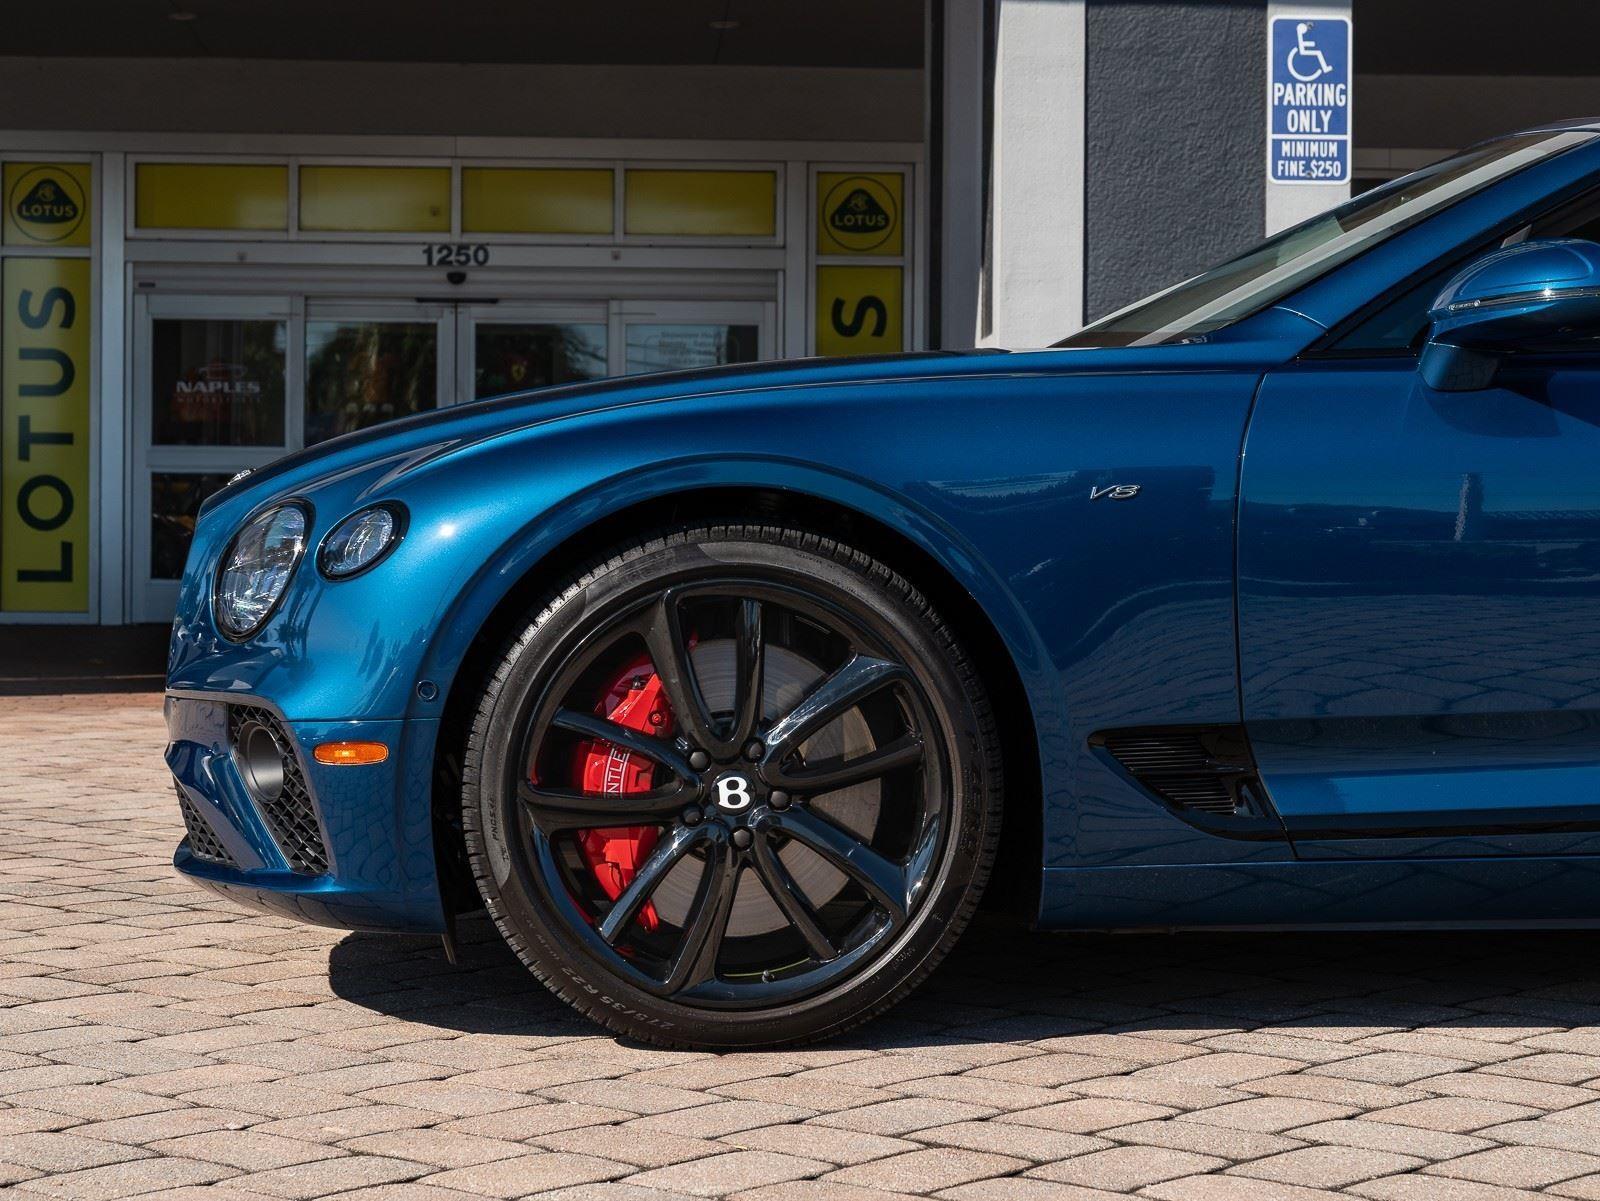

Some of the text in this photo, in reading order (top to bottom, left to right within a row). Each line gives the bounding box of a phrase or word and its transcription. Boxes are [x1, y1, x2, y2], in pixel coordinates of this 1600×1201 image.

[1273, 83, 1347, 107] PARKING
[1286, 109, 1333, 133] ONLY
[1281, 141, 1338, 158] MINIMUM
[1277, 159, 1341, 178] FINE $250
[22, 204, 75, 217] LOTUS
[834, 214, 887, 227] LOTUS
[422, 244, 489, 266] 1250
[176, 381, 261, 393] NAPLES
[17, 286, 75, 583] LOTUS
[1089, 484, 1141, 500] V8
[607, 748, 626, 796] NTLE
[717, 776, 750, 809] B
